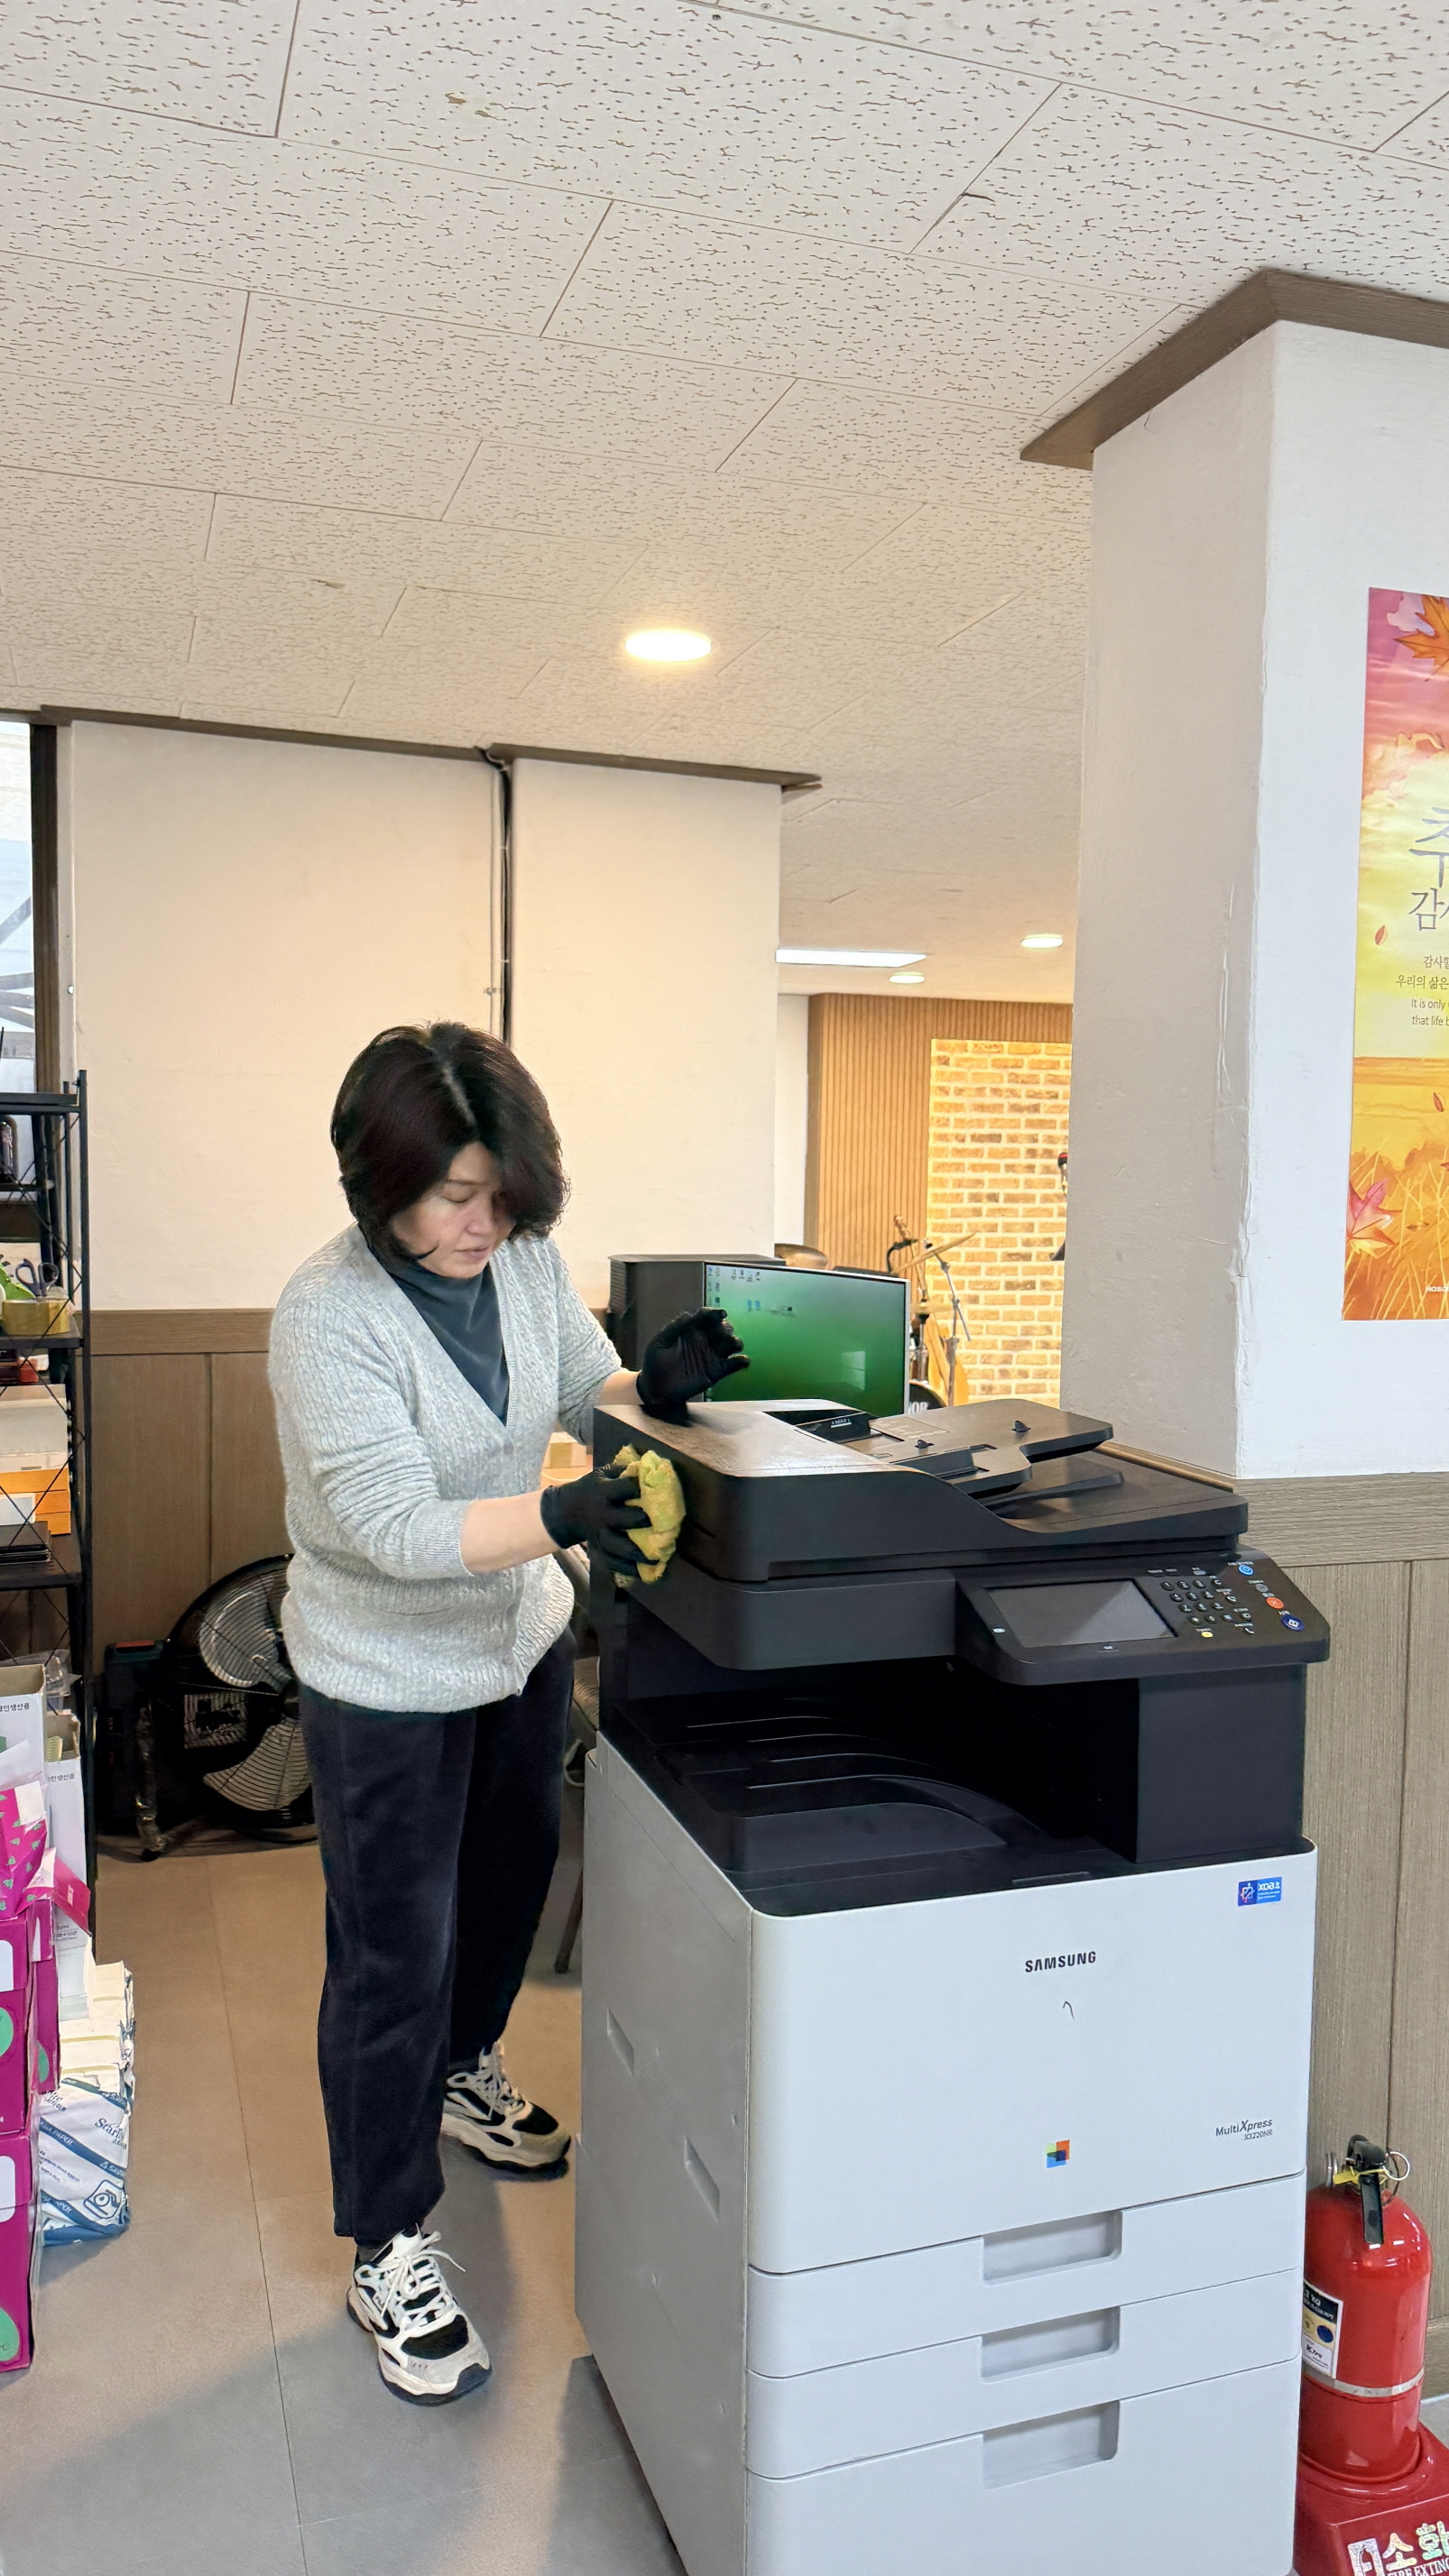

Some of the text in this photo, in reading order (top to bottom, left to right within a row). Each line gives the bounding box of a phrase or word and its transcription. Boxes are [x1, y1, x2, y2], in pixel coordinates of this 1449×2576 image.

[1396, 975, 1426, 989] 우리의
[1419, 998, 1426, 1008] is
[1427, 999, 1445, 1011] only
[1412, 1016, 1429, 1026] that
[1431, 1016, 1444, 1026] life
[1025, 1951, 1096, 1973] SAMSUNG
[1215, 2120, 1273, 2137] MultiXpress
